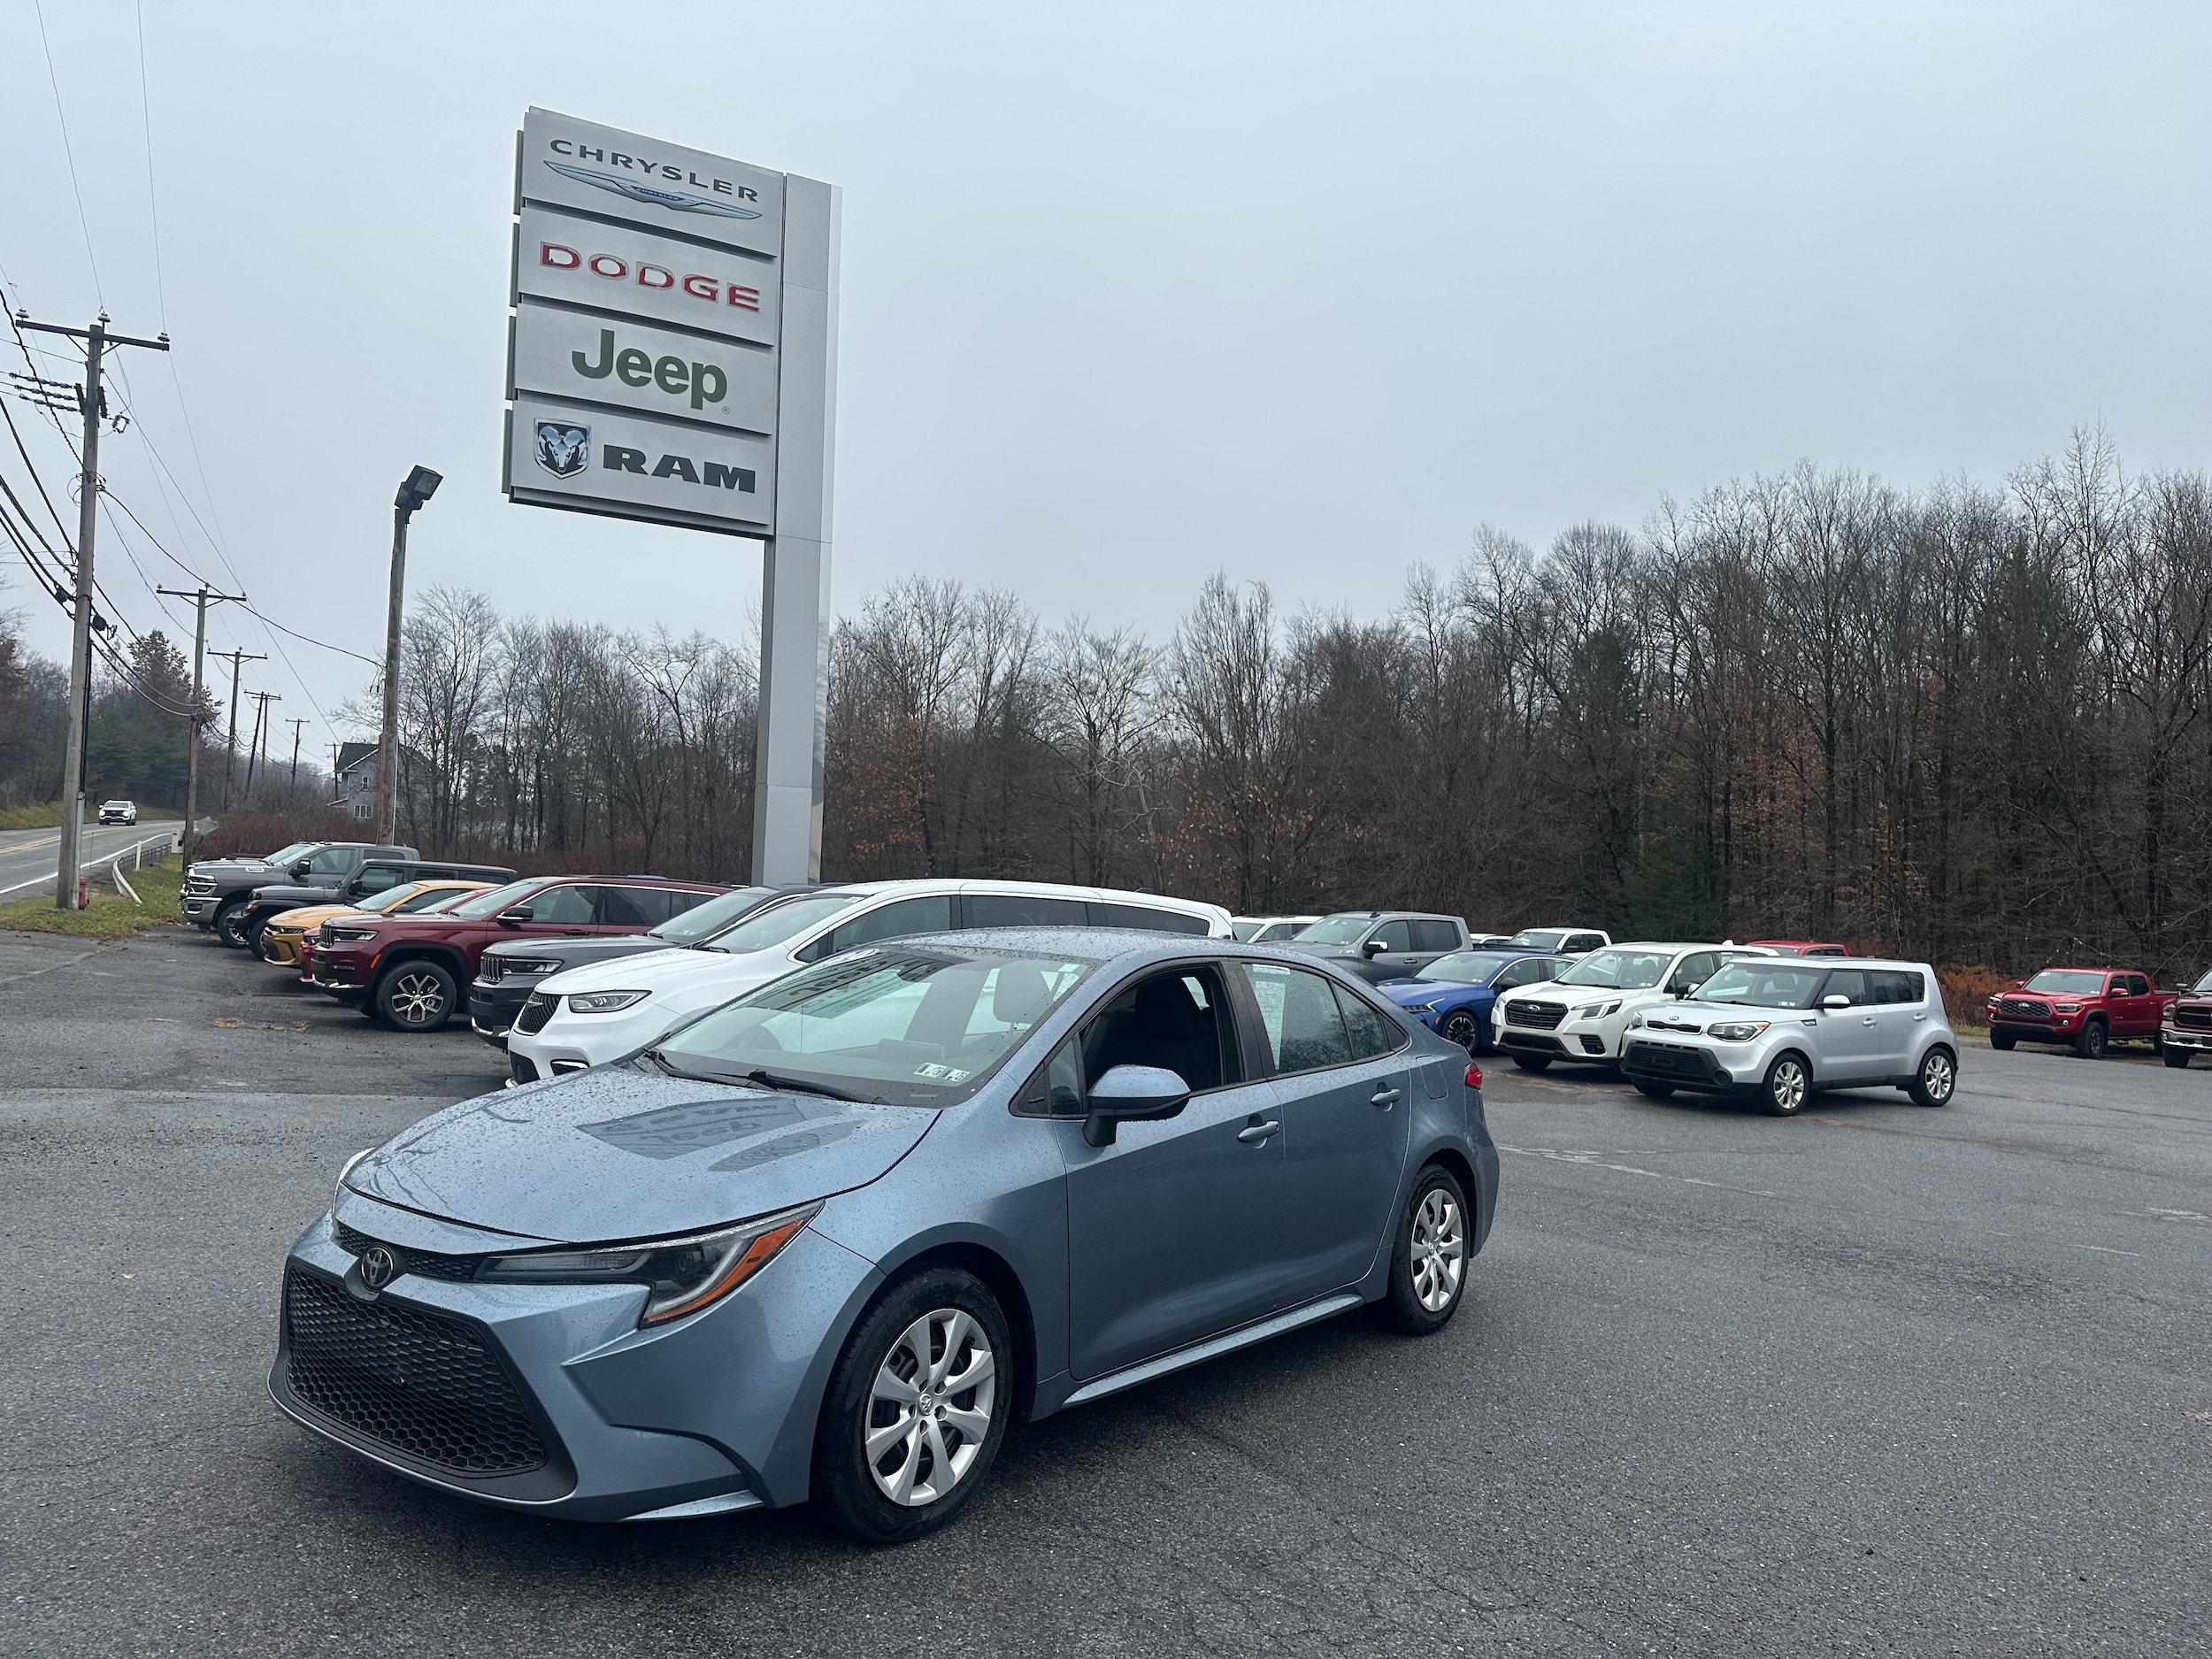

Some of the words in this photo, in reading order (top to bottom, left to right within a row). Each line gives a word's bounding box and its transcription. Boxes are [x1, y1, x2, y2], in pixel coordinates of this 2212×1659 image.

[549, 139, 758, 203] CHRYSLER
[636, 187, 680, 201] CHRYSLER
[540, 242, 760, 313] DODGE
[572, 328, 727, 411] Jeep
[603, 444, 756, 494] RAM
